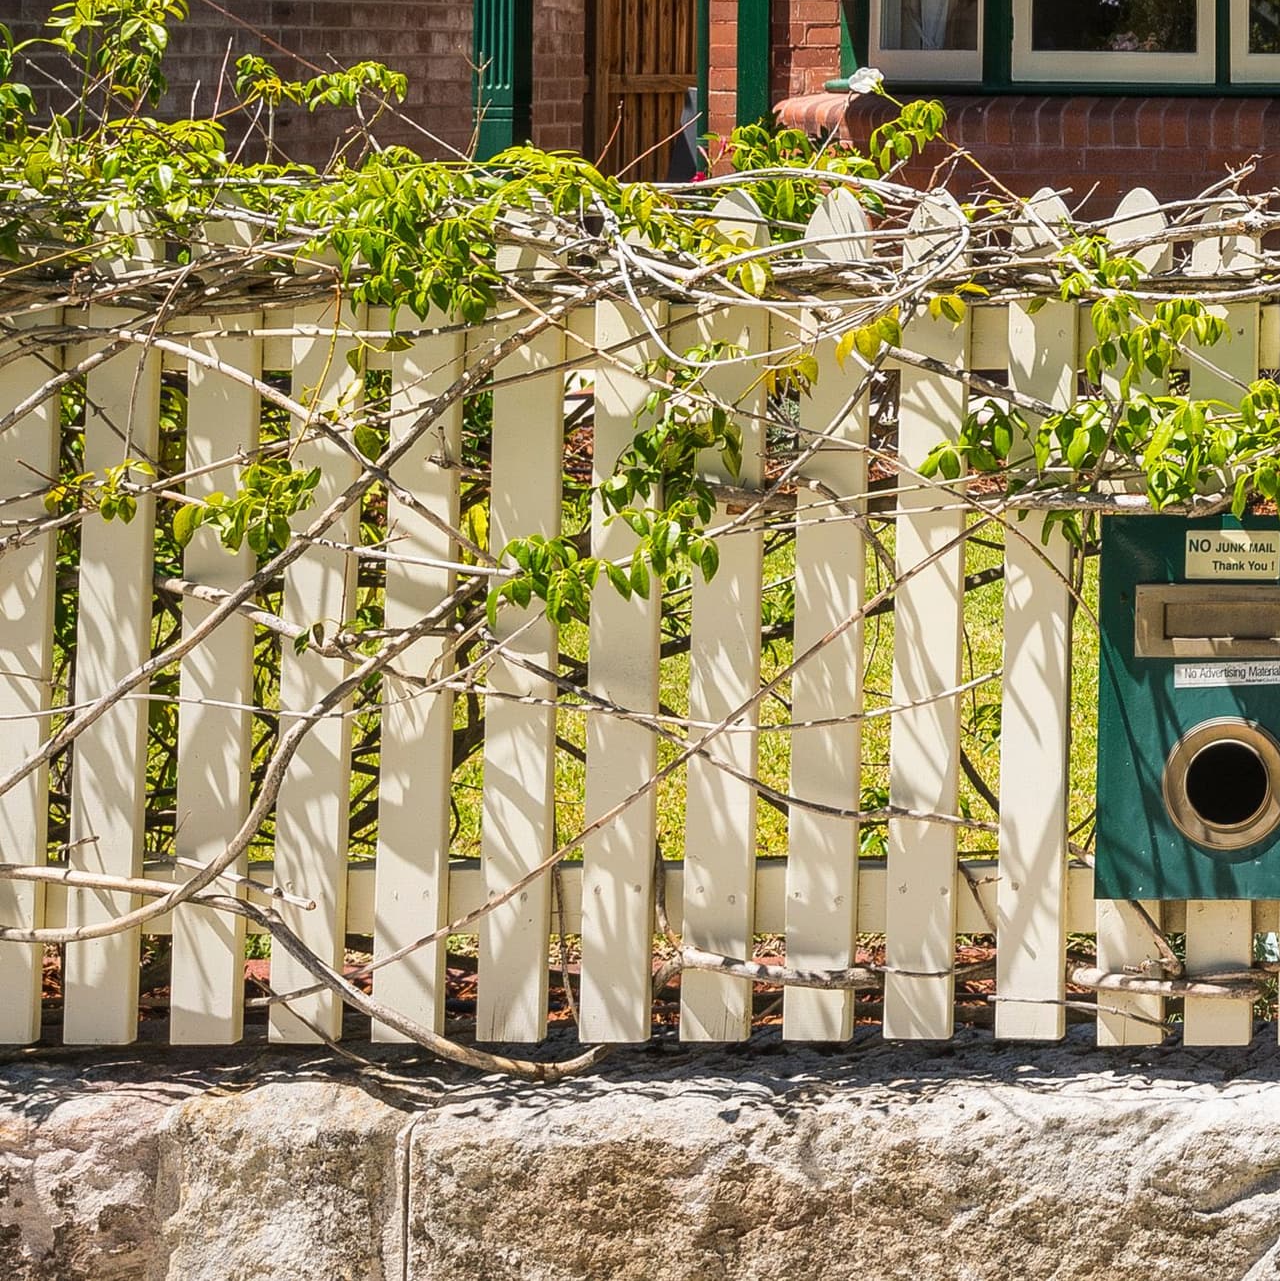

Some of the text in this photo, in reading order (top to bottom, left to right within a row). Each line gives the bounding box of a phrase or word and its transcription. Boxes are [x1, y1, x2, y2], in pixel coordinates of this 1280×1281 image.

[1188, 538, 1276, 553] NO JUNK MAIL
[1211, 560, 1245, 571] Thank
[1247, 560, 1268, 571] You
[1184, 665, 1280, 680] No Advertising Material
